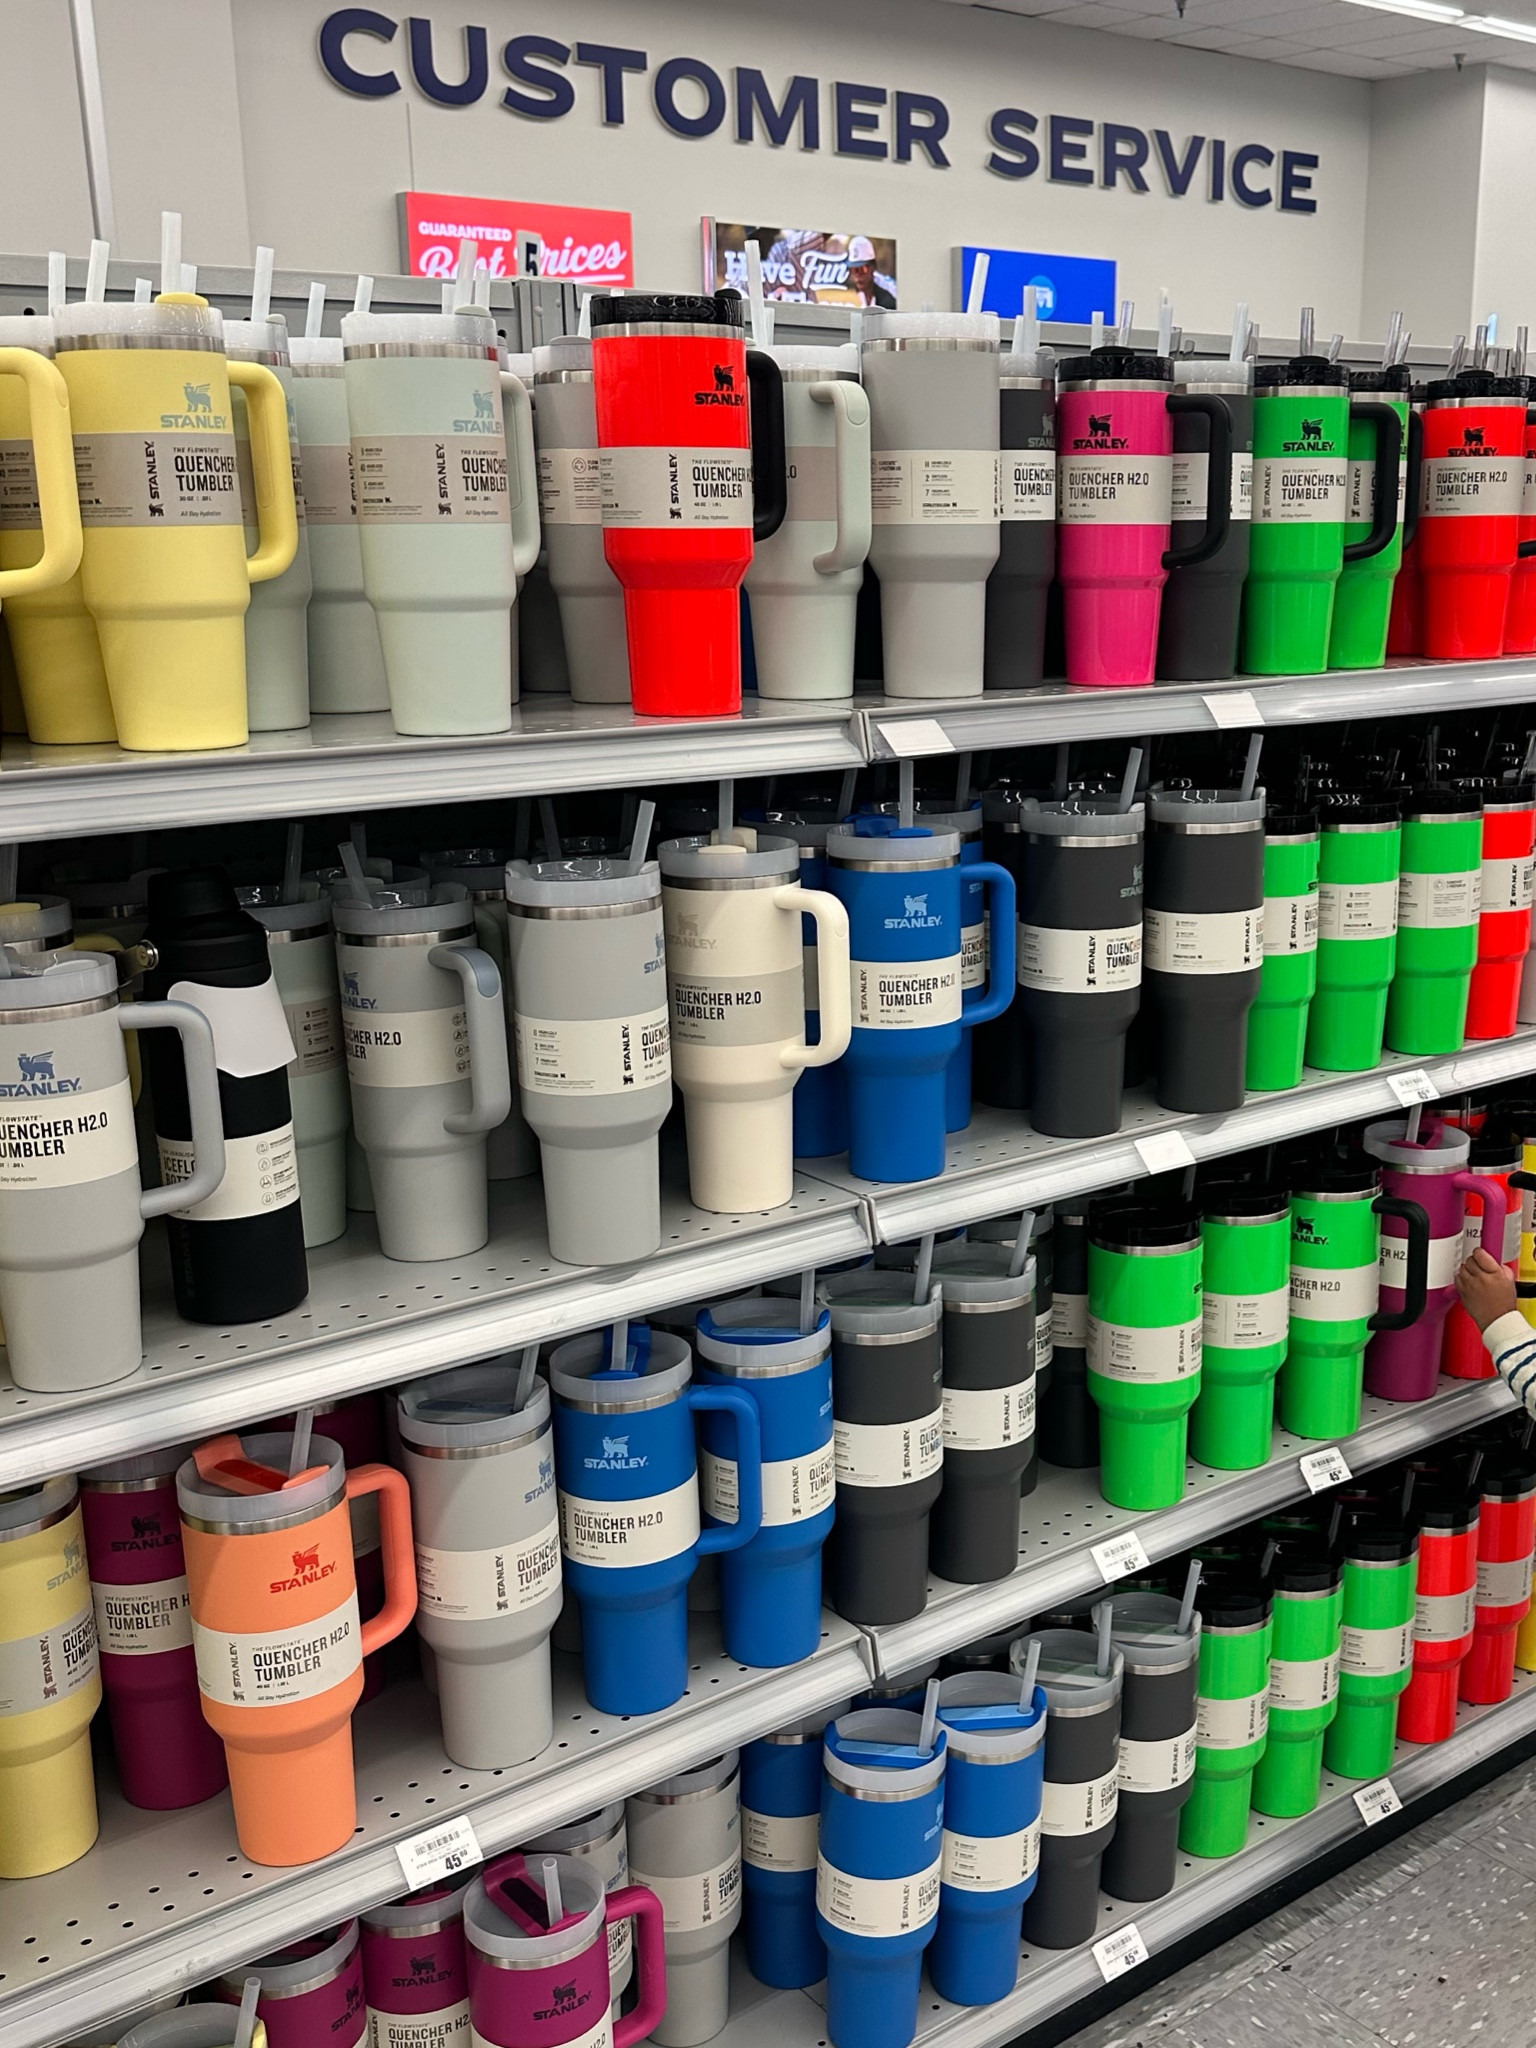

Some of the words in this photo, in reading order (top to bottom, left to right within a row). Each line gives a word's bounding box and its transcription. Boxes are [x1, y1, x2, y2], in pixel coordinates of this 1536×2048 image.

[319, 8, 951, 167] CUSTOMER
[986, 109, 1319, 213] SERVICE
[418, 221, 512, 242] GUARANTEED
[724, 250, 797, 285] Hve
[800, 250, 849, 290] Fun
[695, 392, 744, 406] STANLEY
[160, 414, 227, 429] STANLEY
[453, 420, 503, 433] STANLE
[1027, 437, 1055, 447] STANL
[1073, 438, 1128, 449] STANLEY
[1282, 441, 1334, 451] STANLEY
[1448, 447, 1497, 457] STANLEY
[144, 440, 160, 500] STANLEY
[175, 455, 236, 473] QUENCHER
[436, 443, 449, 499] STANLEY
[462, 458, 507, 474] QUENCHE
[668, 454, 679, 504] STANLEY
[692, 467, 745, 482] QUENCHER
[1014, 468, 1054, 481] QUENCHE
[1069, 473, 1124, 485] QUENCHER
[1127, 472, 1149, 485] H2.0
[1282, 474, 1334, 487] QUENCHER
[1436, 472, 1486, 484] QUENCHER
[1490, 471, 1507, 483] H2.0
[175, 474, 234, 492] TUMBLER
[693, 483, 743, 497] TUMBLER
[1436, 485, 1479, 496] TUMBLER
[1069, 487, 1116, 499] TUMBLER
[1282, 488, 1328, 500] TUMBLER
[884, 916, 942, 929] STANLEY
[1088, 935, 1096, 974] STANLEY
[1106, 939, 1141, 956] QUENCHE
[879, 979, 939, 992] QUENCHER
[676, 990, 732, 1006] QUENCHER
[736, 991, 761, 1005] H2.0
[879, 992, 933, 1006] TUMBLER
[676, 1004, 724, 1020] TUMBLER
[375, 1031, 401, 1046] H2.0
[622, 1024, 630, 1071] STANLEY
[0, 1119, 74, 1140] UENCHER
[78, 1112, 108, 1133] H2.0
[0, 1139, 65, 1158] UMBLER
[164, 1156, 195, 1174] ICEFL
[1291, 1233, 1328, 1245] ANLEY
[1466, 1229, 1482, 1238] H2.
[1393, 1251, 1407, 1260] H2.
[1290, 1288, 1311, 1300] BLER
[1320, 1282, 1340, 1291] H2.0
[902, 1430, 910, 1467] STANLEY
[584, 1456, 648, 1470] STANLEY
[1329, 1471, 1340, 1481] 45
[574, 1514, 635, 1530] QUENCHER
[638, 1511, 663, 1528] H2.0
[111, 1533, 181, 1552] STANLEY
[574, 1526, 627, 1544] TUMBLER
[518, 1552, 558, 1586] TUMBLER
[1124, 1559, 1136, 1570] 45
[270, 1560, 336, 1594] STANLEY
[496, 1555, 506, 1597] STANLEY
[106, 1597, 179, 1616] QUENCHER
[106, 1613, 171, 1631] TUMBLER
[253, 1636, 328, 1667] QUENCHER
[331, 1621, 350, 1646] H2.0
[40, 1638, 53, 1684] STANLEY
[229, 1643, 242, 1688] STANLEY
[255, 1655, 321, 1682] TUMBLER
[1381, 1803, 1390, 1813] 45
[445, 1854, 461, 1870] 45
[1124, 1953, 1136, 1965] 45
[392, 1969, 453, 1988] STANLEY
[533, 1992, 591, 2020] STANLEY
[389, 2021, 453, 2040] QUENCHER
[455, 2013, 470, 2032] H2.
